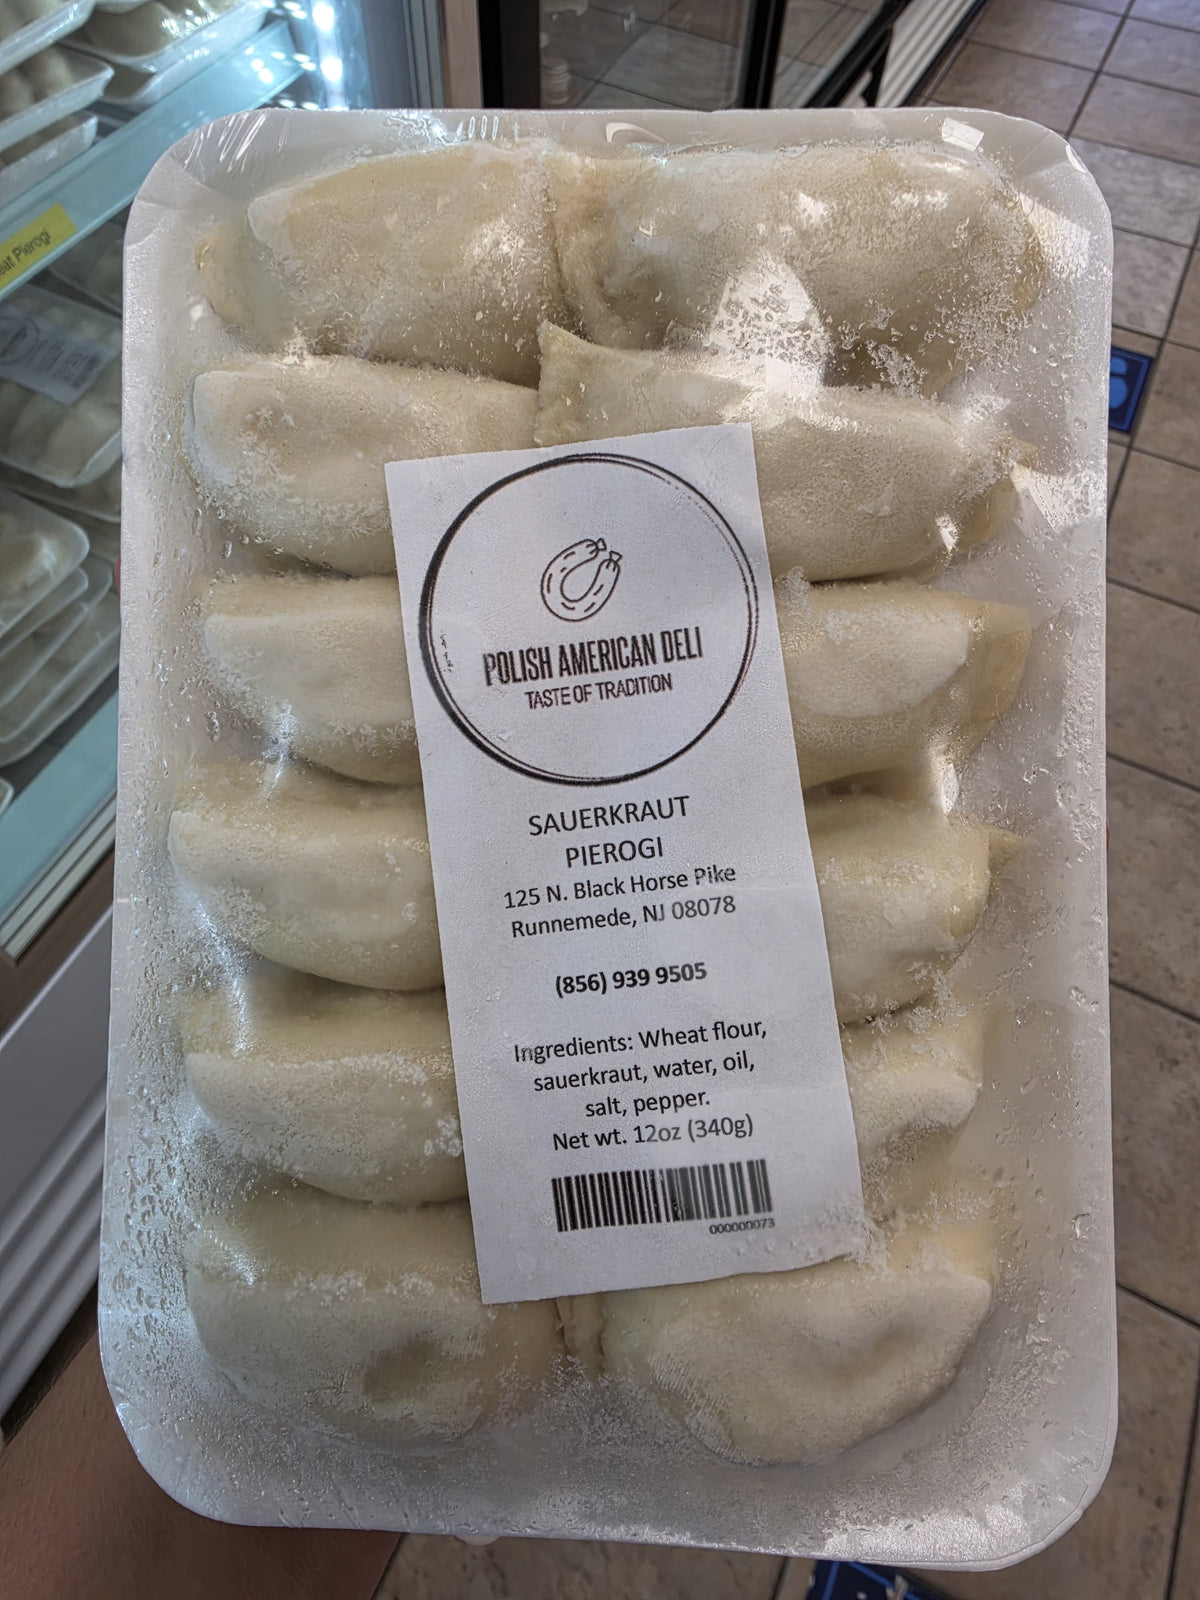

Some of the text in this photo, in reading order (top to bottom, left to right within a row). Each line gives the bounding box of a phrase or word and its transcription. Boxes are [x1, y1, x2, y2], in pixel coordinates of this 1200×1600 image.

[0, 226, 50, 275] eat Pierogi
[483, 626, 703, 687] POLISH AMERICAN DELI
[525, 673, 673, 709] TASTE OF TRADITION
[529, 795, 690, 836] SAUERKRAUT
[566, 836, 663, 868] PIEROGI
[504, 864, 736, 909] 125 N. Black Horse Pike
[512, 895, 736, 938] Runnemede, NJ 08078
[556, 962, 707, 998] (856) 939 9505
[514, 1020, 767, 1066] Ingredients: Wheat flour,
[534, 1050, 755, 1092] sauerkraut, water, oil,
[585, 1090, 710, 1117] salt, pepper.
[553, 1113, 753, 1151] Net wt. 12oz (340g)
